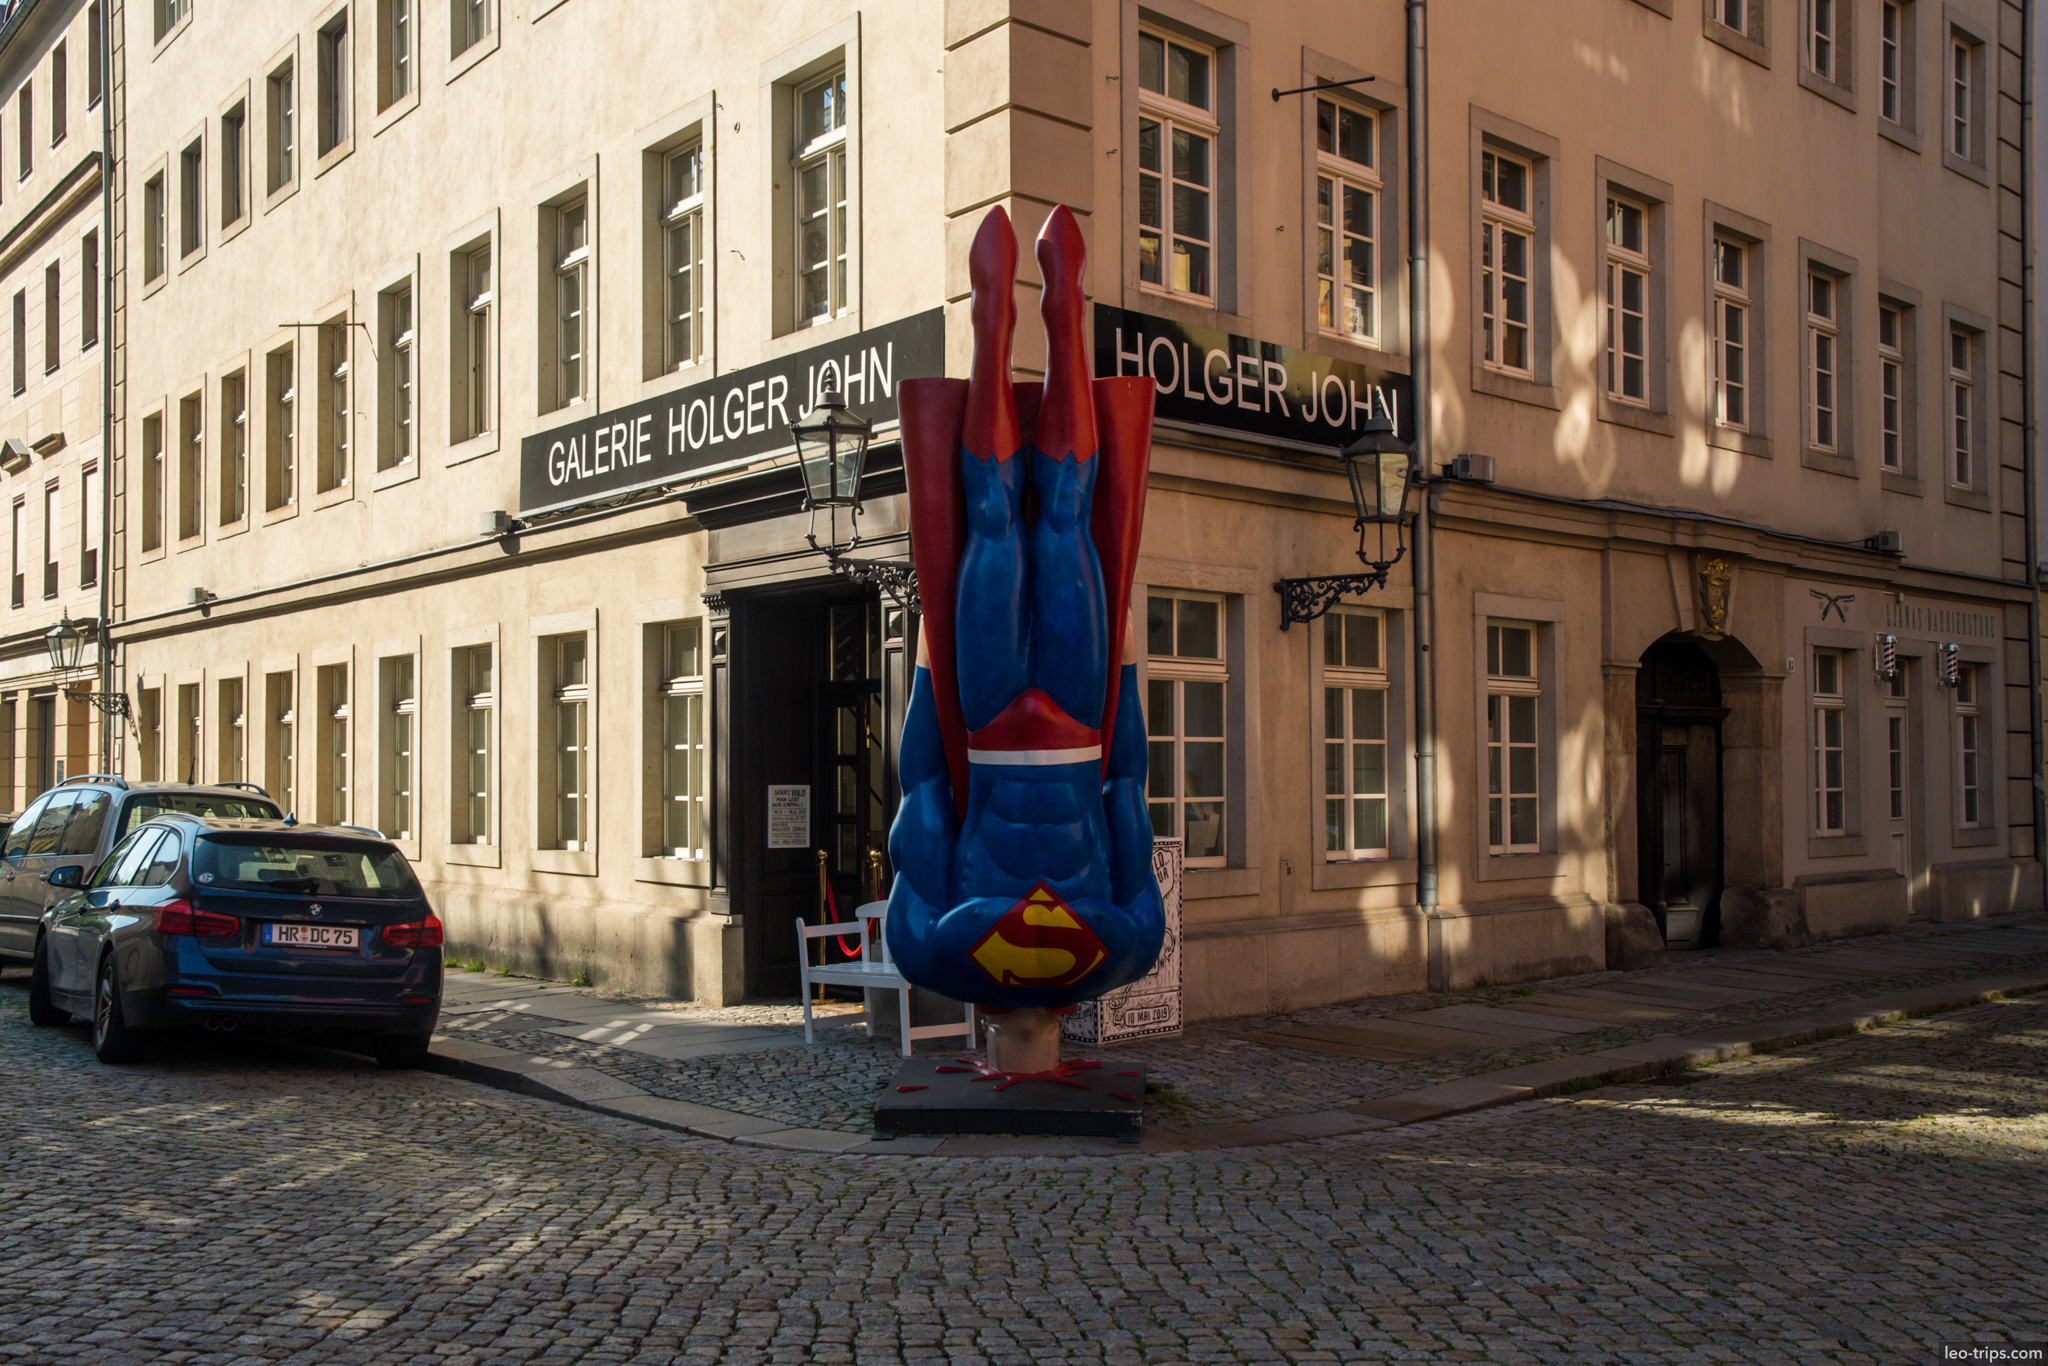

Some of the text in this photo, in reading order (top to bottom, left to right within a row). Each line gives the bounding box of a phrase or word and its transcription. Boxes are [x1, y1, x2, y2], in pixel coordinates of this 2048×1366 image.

[1116, 327, 1398, 437] HOLGER JOHN
[548, 341, 893, 487] GALERIE HOLGER JOHN
[1927, 608, 1994, 638] BARBIERSTUBE
[791, 789, 806, 797] YOLO
[279, 926, 352, 945] HR DC 75
[1137, 1010, 1151, 1023] MAI
[1152, 1008, 1168, 1021] 2019
